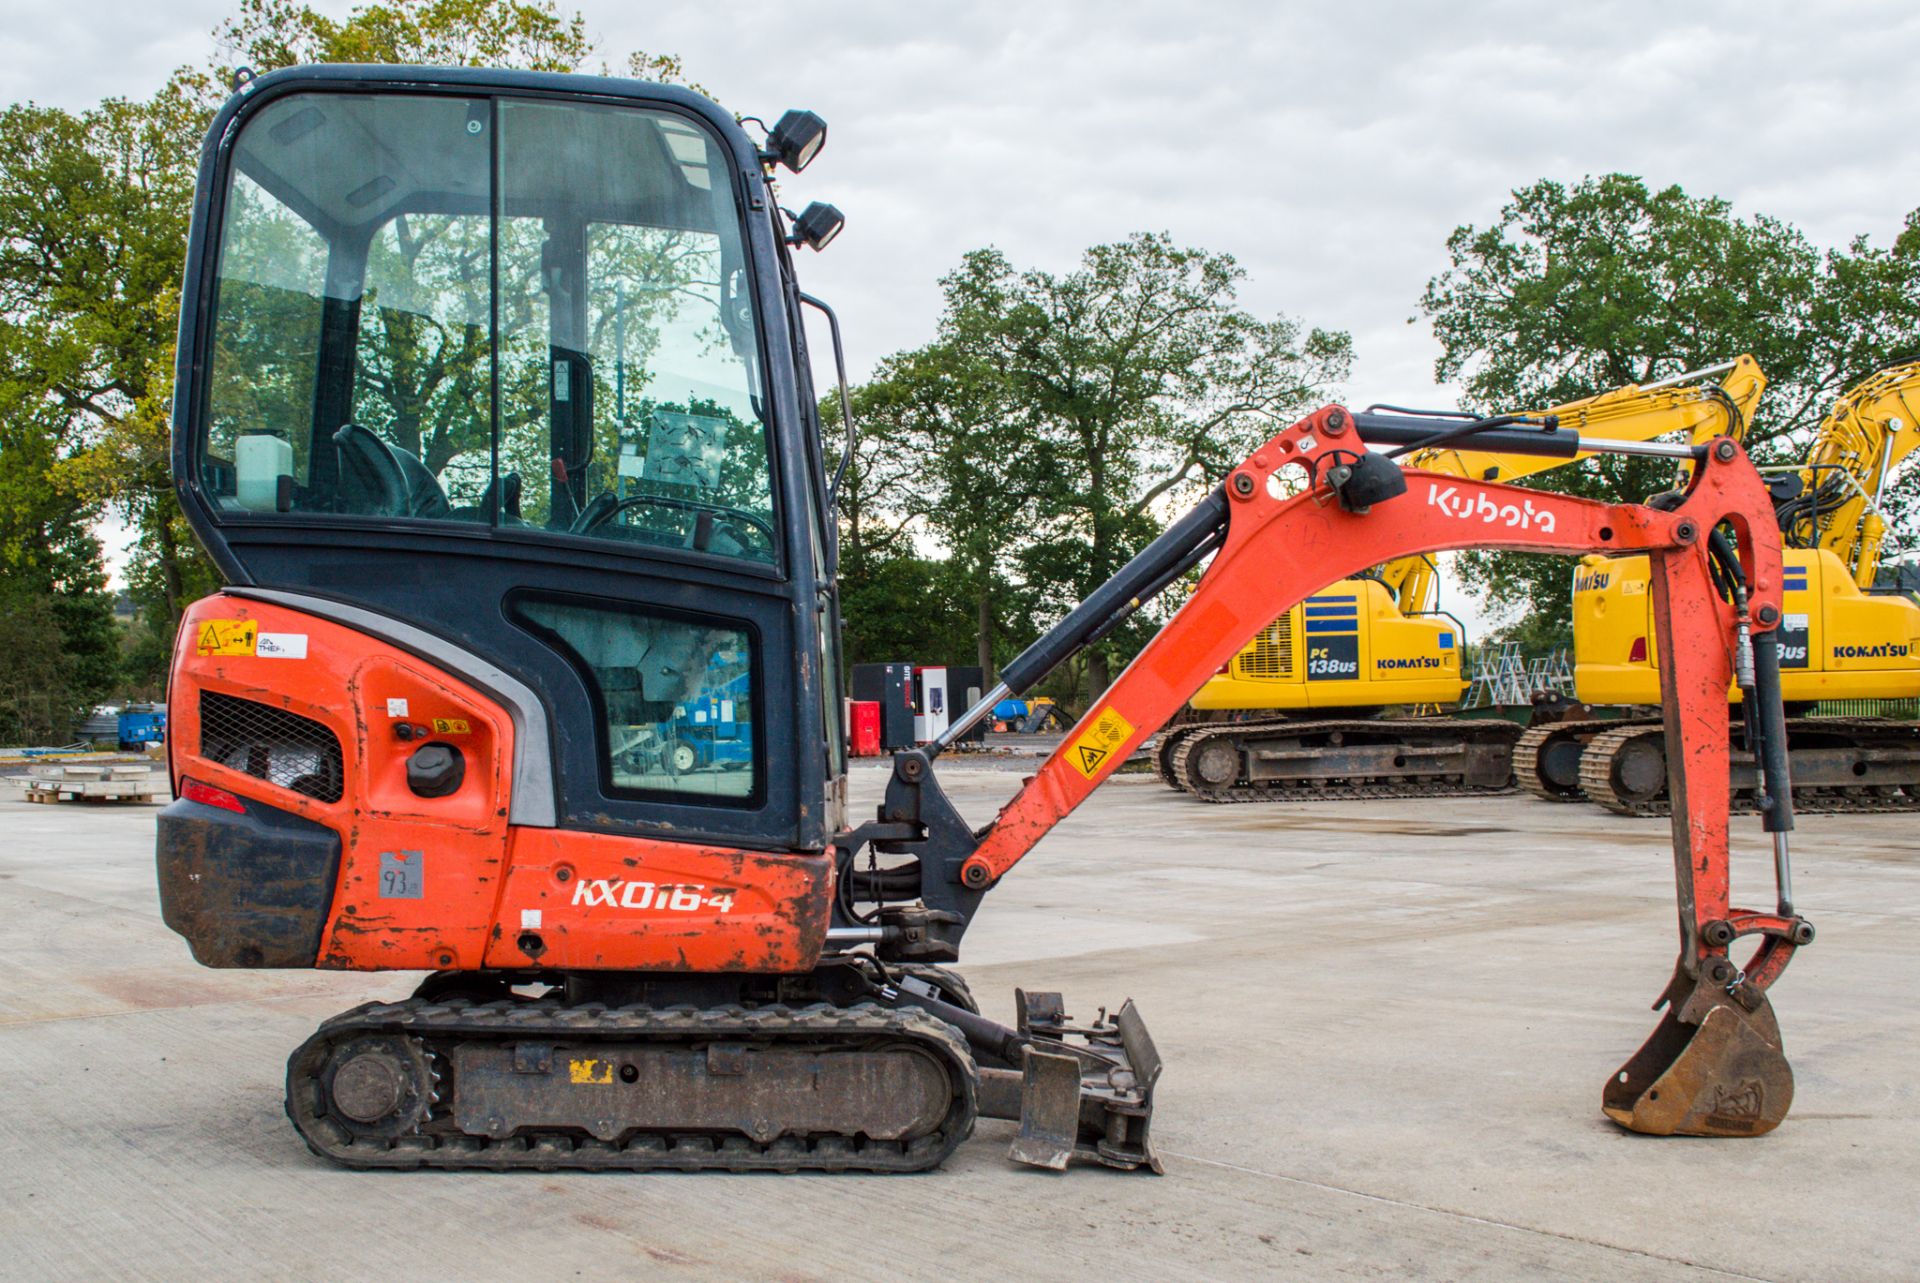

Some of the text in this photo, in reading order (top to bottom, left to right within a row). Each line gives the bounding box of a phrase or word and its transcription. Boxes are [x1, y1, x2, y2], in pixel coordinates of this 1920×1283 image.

[1428, 483, 1556, 533] Kubota
[1310, 648, 1329, 659] PC
[1833, 642, 1908, 657] KOMATSU
[1377, 656, 1440, 668] KOMATSU
[384, 870, 407, 894] 93
[571, 879, 735, 913] KX016-4
